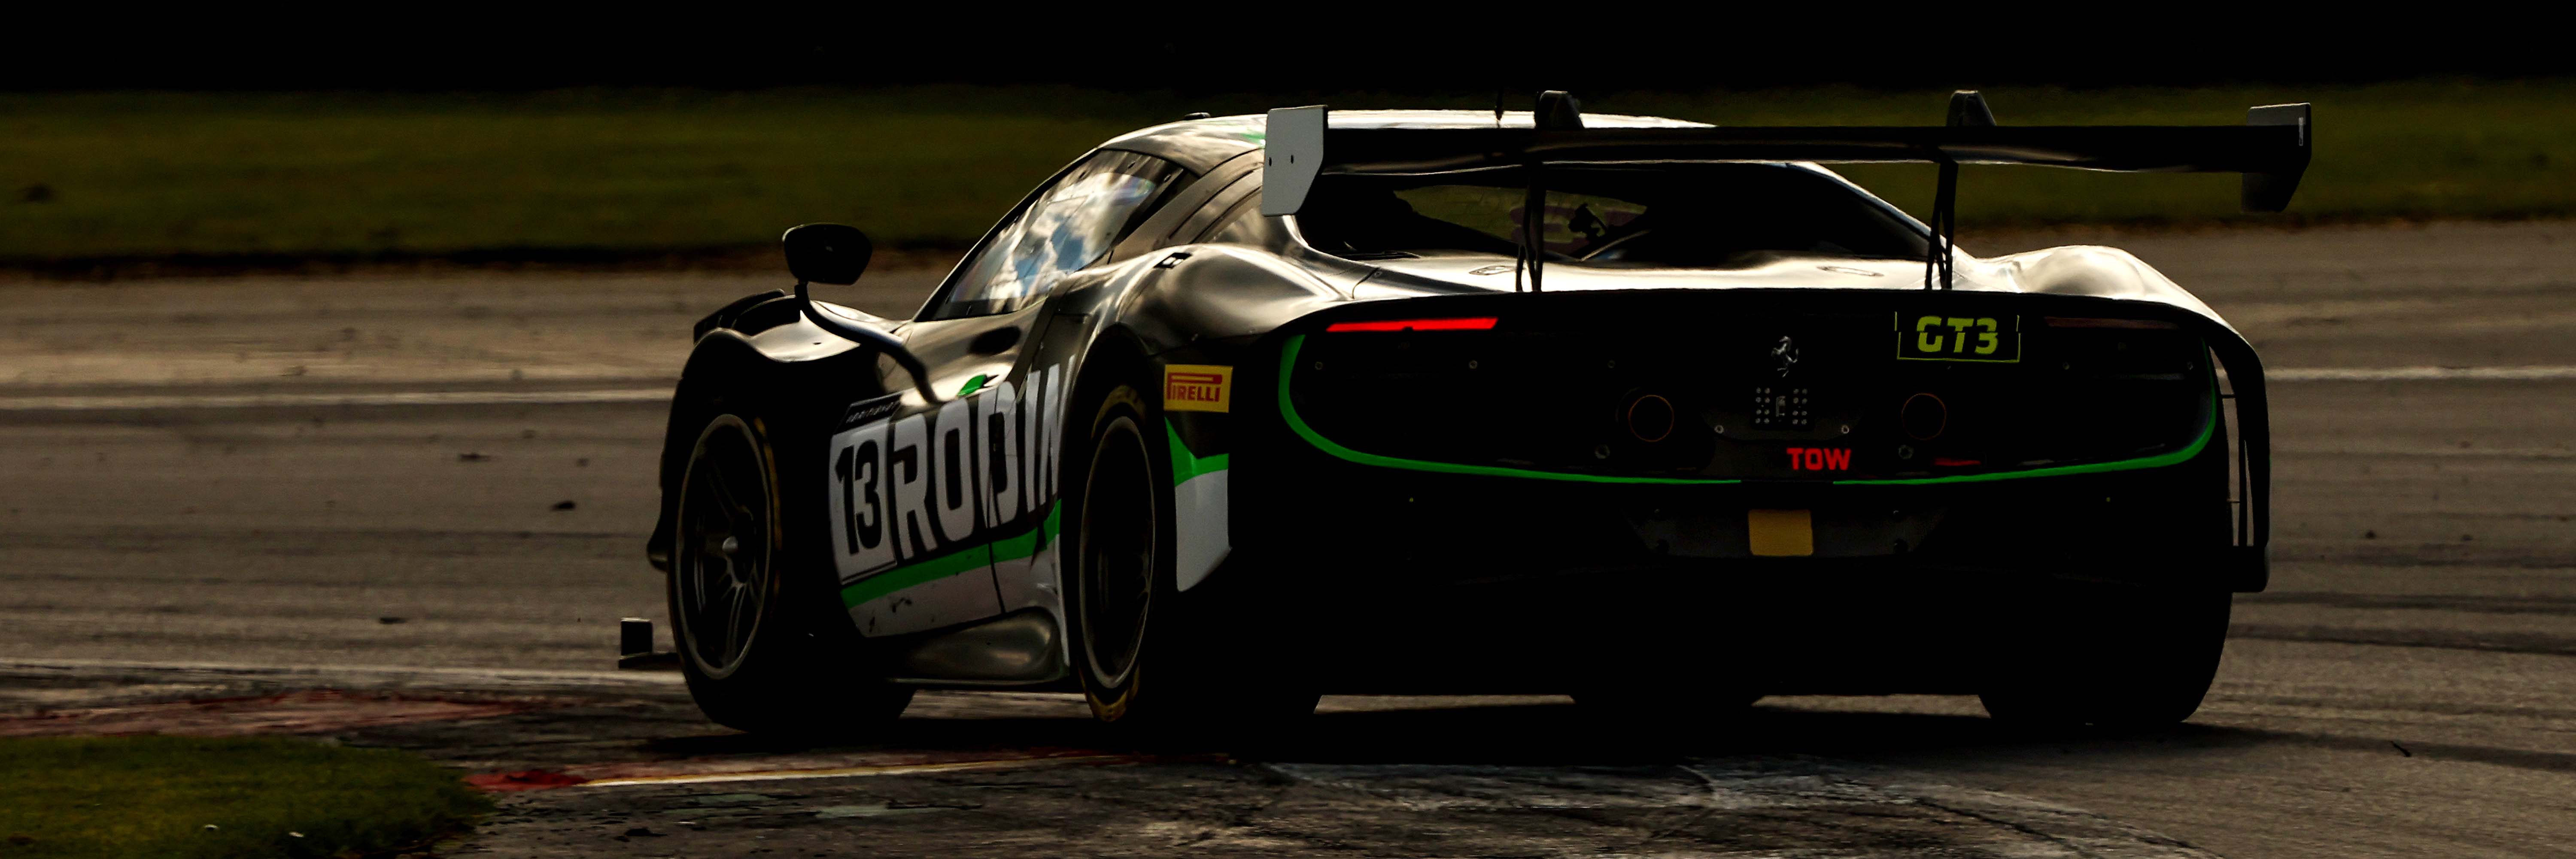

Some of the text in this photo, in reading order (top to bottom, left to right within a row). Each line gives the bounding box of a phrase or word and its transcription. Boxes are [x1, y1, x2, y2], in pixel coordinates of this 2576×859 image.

[1917, 315, 1999, 355] GT3
[1167, 373, 1222, 402] PIRELLI
[893, 354, 1076, 562] RODIN
[1786, 446, 1852, 471] TOW
[836, 439, 882, 556] 13
